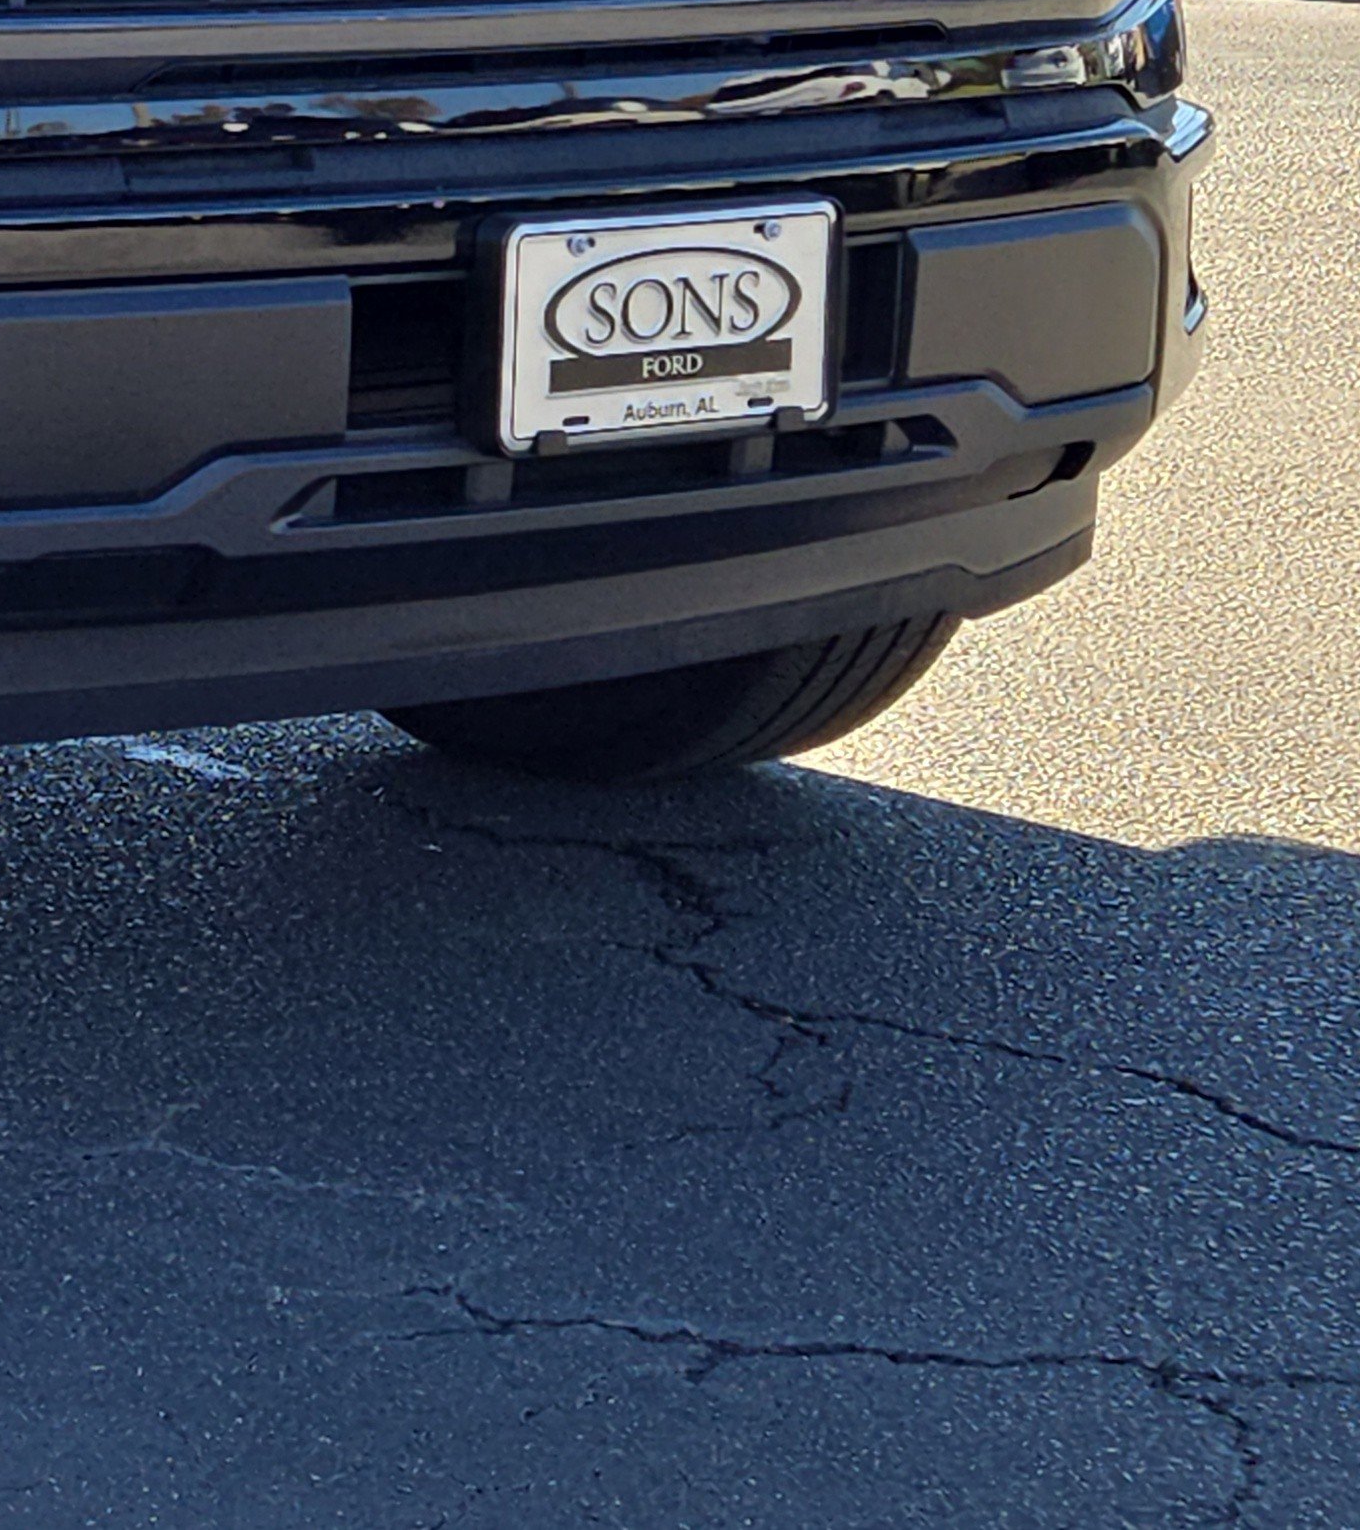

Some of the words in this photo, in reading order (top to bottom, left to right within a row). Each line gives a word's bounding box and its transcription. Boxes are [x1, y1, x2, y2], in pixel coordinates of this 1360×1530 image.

[585, 270, 760, 347] SONS
[641, 353, 703, 379] FORD
[623, 398, 691, 422] Auburn,
[695, 396, 720, 414] AL
